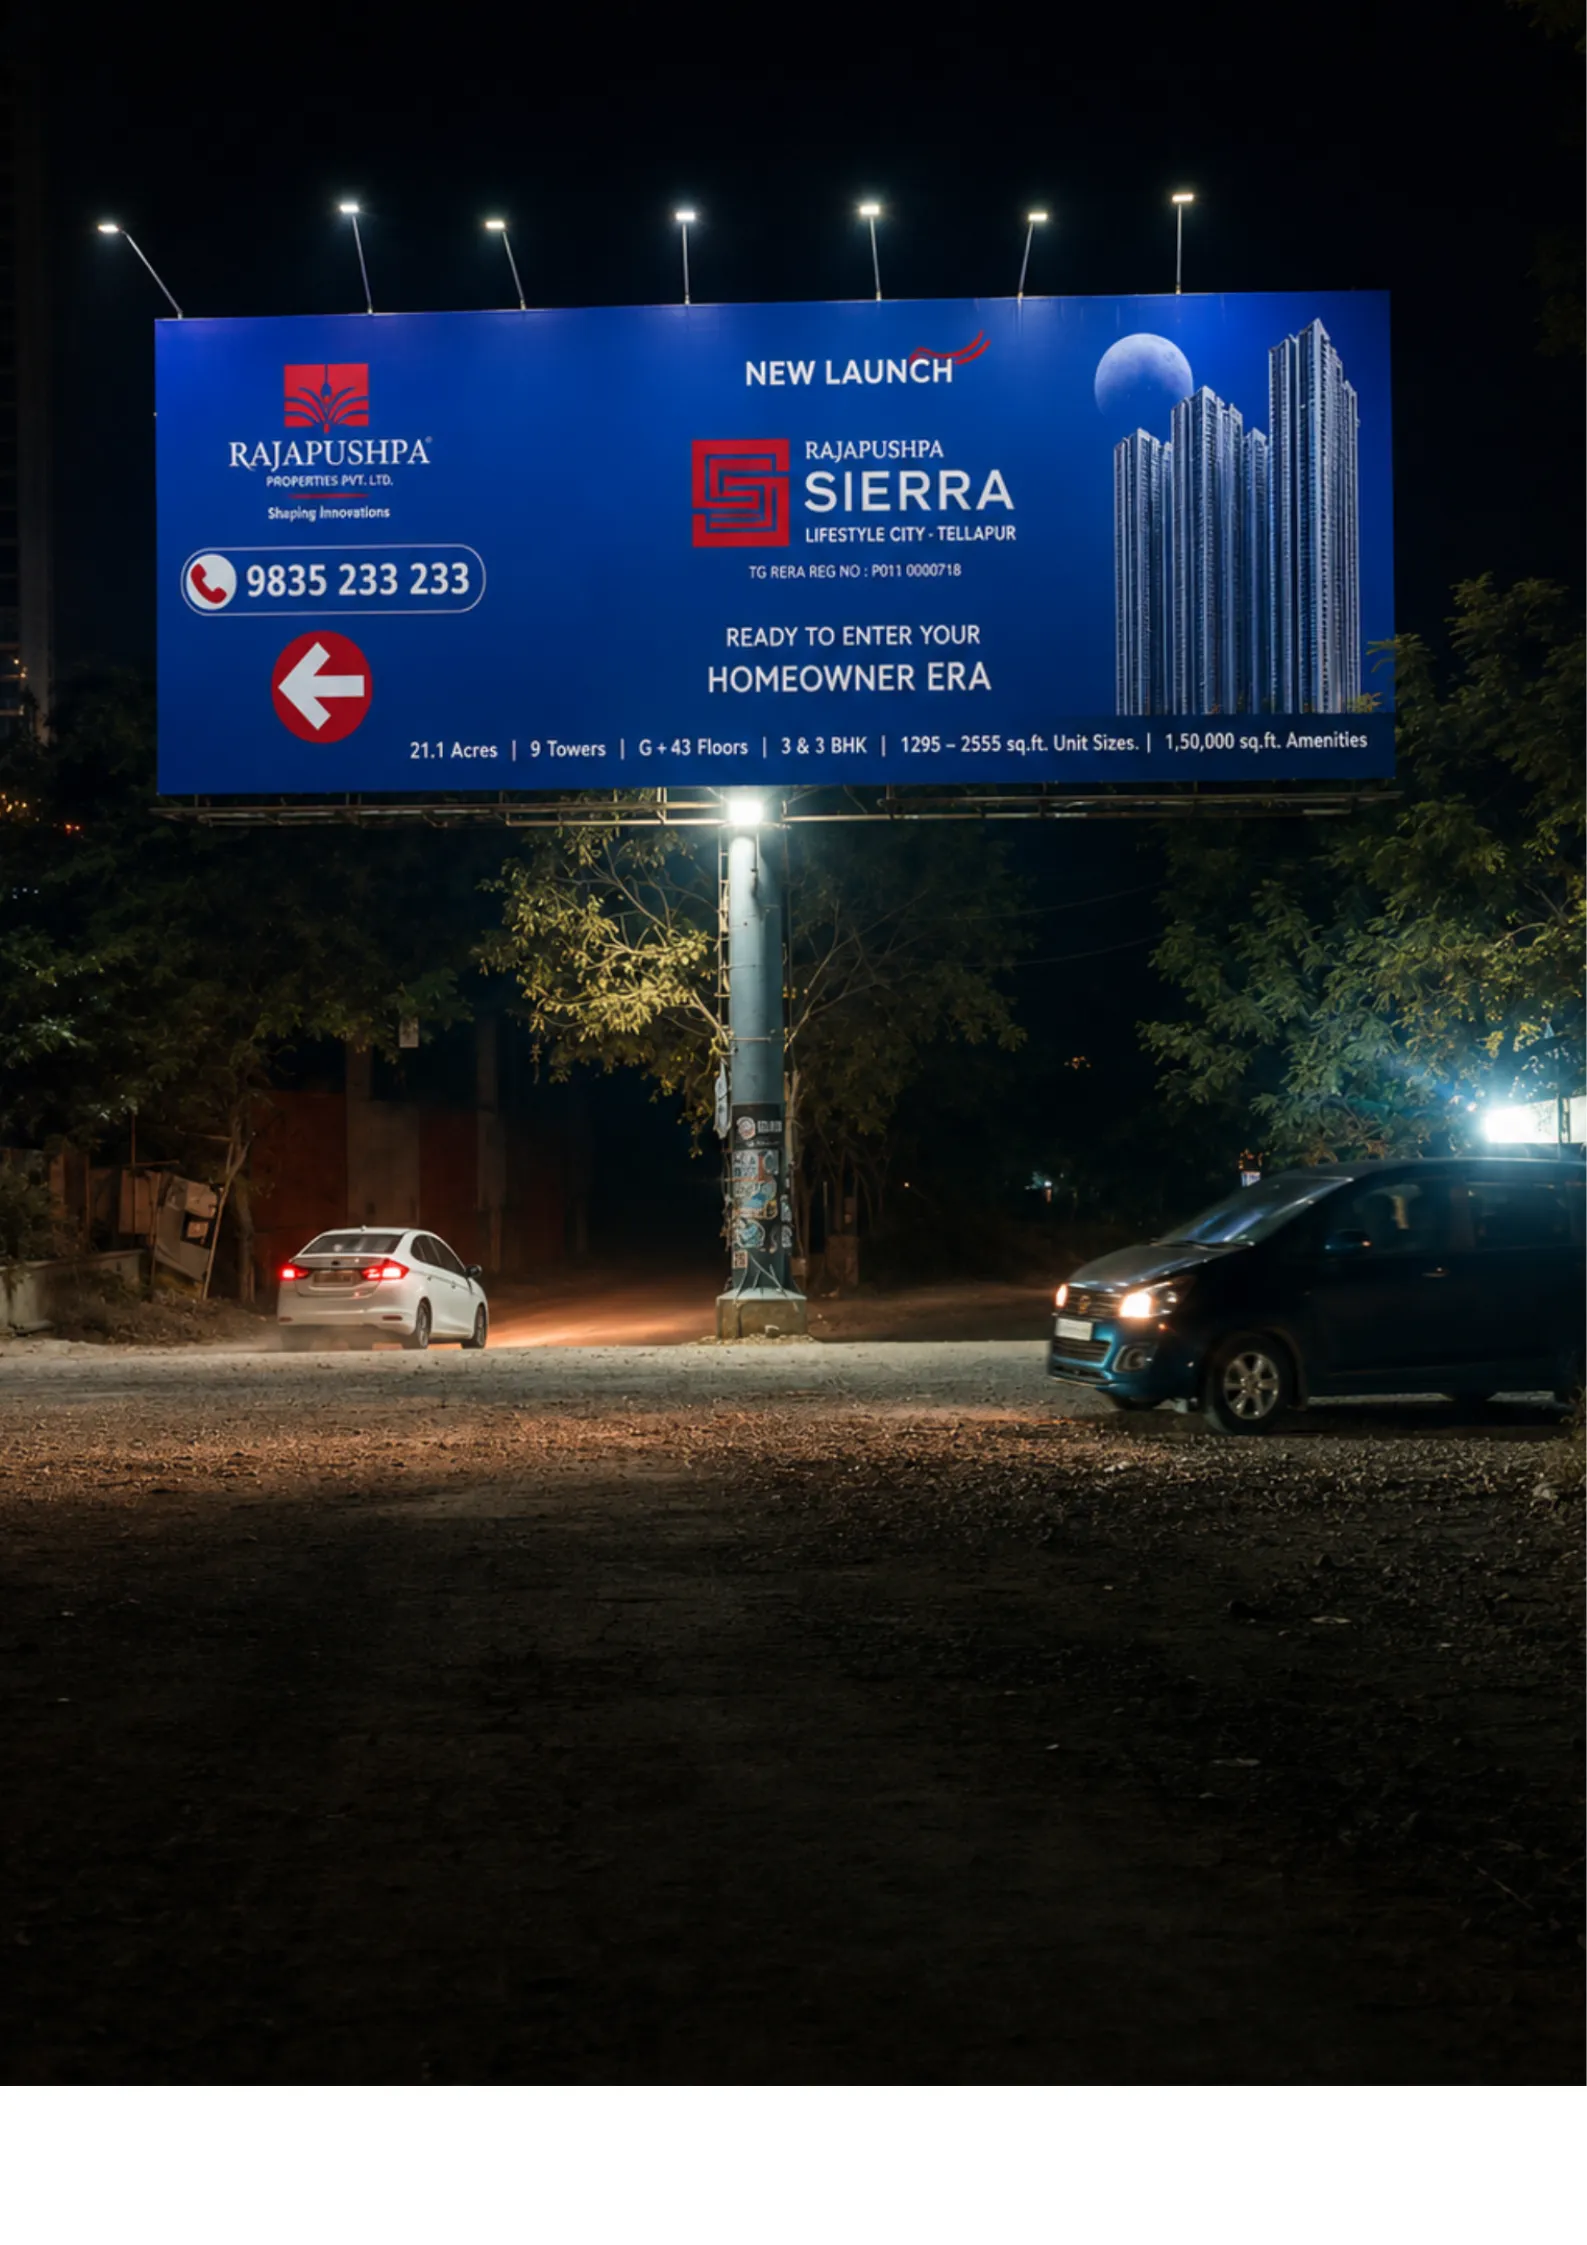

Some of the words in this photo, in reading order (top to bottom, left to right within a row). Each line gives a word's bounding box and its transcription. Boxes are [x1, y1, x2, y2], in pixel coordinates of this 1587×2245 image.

[746, 360, 815, 386] NEW
[825, 357, 953, 385] LAUNCH
[229, 439, 430, 472] RAJAPUSHPA
[805, 439, 944, 463] RAJAPUSHPA
[266, 474, 338, 488] PROPERTIES
[369, 474, 393, 486] LTD.
[804, 469, 1015, 513] SIERRA
[267, 506, 316, 522] Shaping
[319, 505, 391, 519] Innovations
[805, 526, 885, 543] LIFESTYLE
[889, 526, 925, 542] CITY
[937, 524, 1017, 541] TELLAPUR
[246, 563, 327, 598] 9835
[338, 562, 398, 596] 233
[410, 562, 470, 595] 233
[749, 565, 767, 579] TG
[770, 564, 806, 579] RERA
[809, 564, 836, 578] REG
[839, 564, 861, 578] NO
[726, 626, 798, 647] READY
[804, 626, 836, 646] TO
[842, 625, 913, 646] ENTER
[919, 624, 981, 645] YOUR
[708, 664, 915, 693] HOMEOWNER
[927, 661, 992, 691] ERA
[410, 741, 444, 759] 21.1
[450, 741, 498, 759] Acres
[530, 740, 541, 758] 9
[546, 739, 607, 758] Towers
[638, 738, 653, 757] G
[670, 738, 692, 756] 43
[697, 737, 749, 757] Floors
[781, 737, 792, 755] 3
[796, 737, 810, 755] &
[815, 737, 826, 754] 3
[831, 736, 867, 754] BHK
[901, 735, 942, 753] 1295
[960, 734, 1002, 753] 2555
[1006, 734, 1049, 756] sq.ft.
[1053, 733, 1089, 752] Unit
[1092, 733, 1139, 751] Sizes.
[1165, 731, 1235, 753] 1,50,000
[1239, 731, 1282, 753] sq.ft.
[1286, 730, 1368, 749] Amenities
